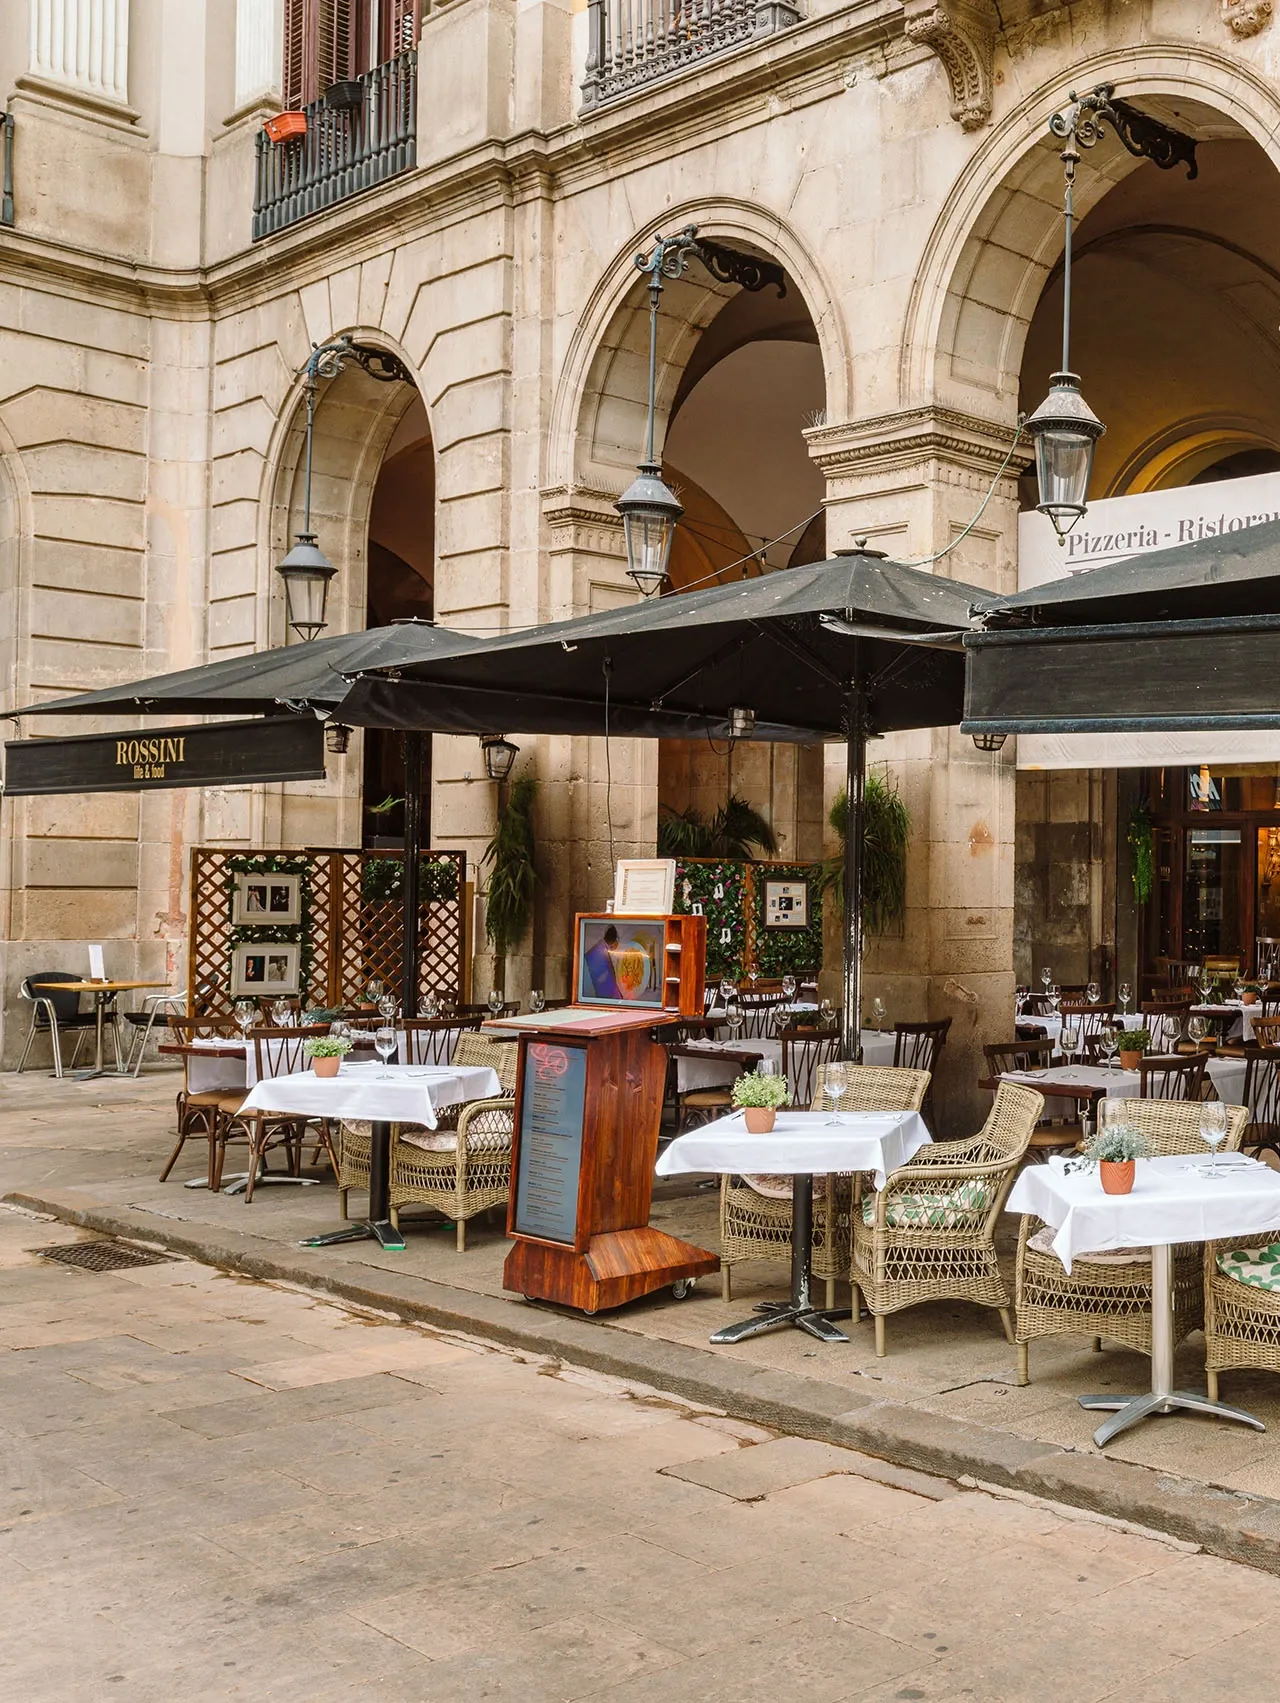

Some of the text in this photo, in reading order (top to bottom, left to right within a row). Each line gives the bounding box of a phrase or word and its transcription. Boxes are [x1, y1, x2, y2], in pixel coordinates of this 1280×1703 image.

[1068, 525, 1160, 556] Pizzeria
[116, 737, 186, 765] ROSSINI
[133, 765, 144, 779] life
[151, 763, 165, 778] food
